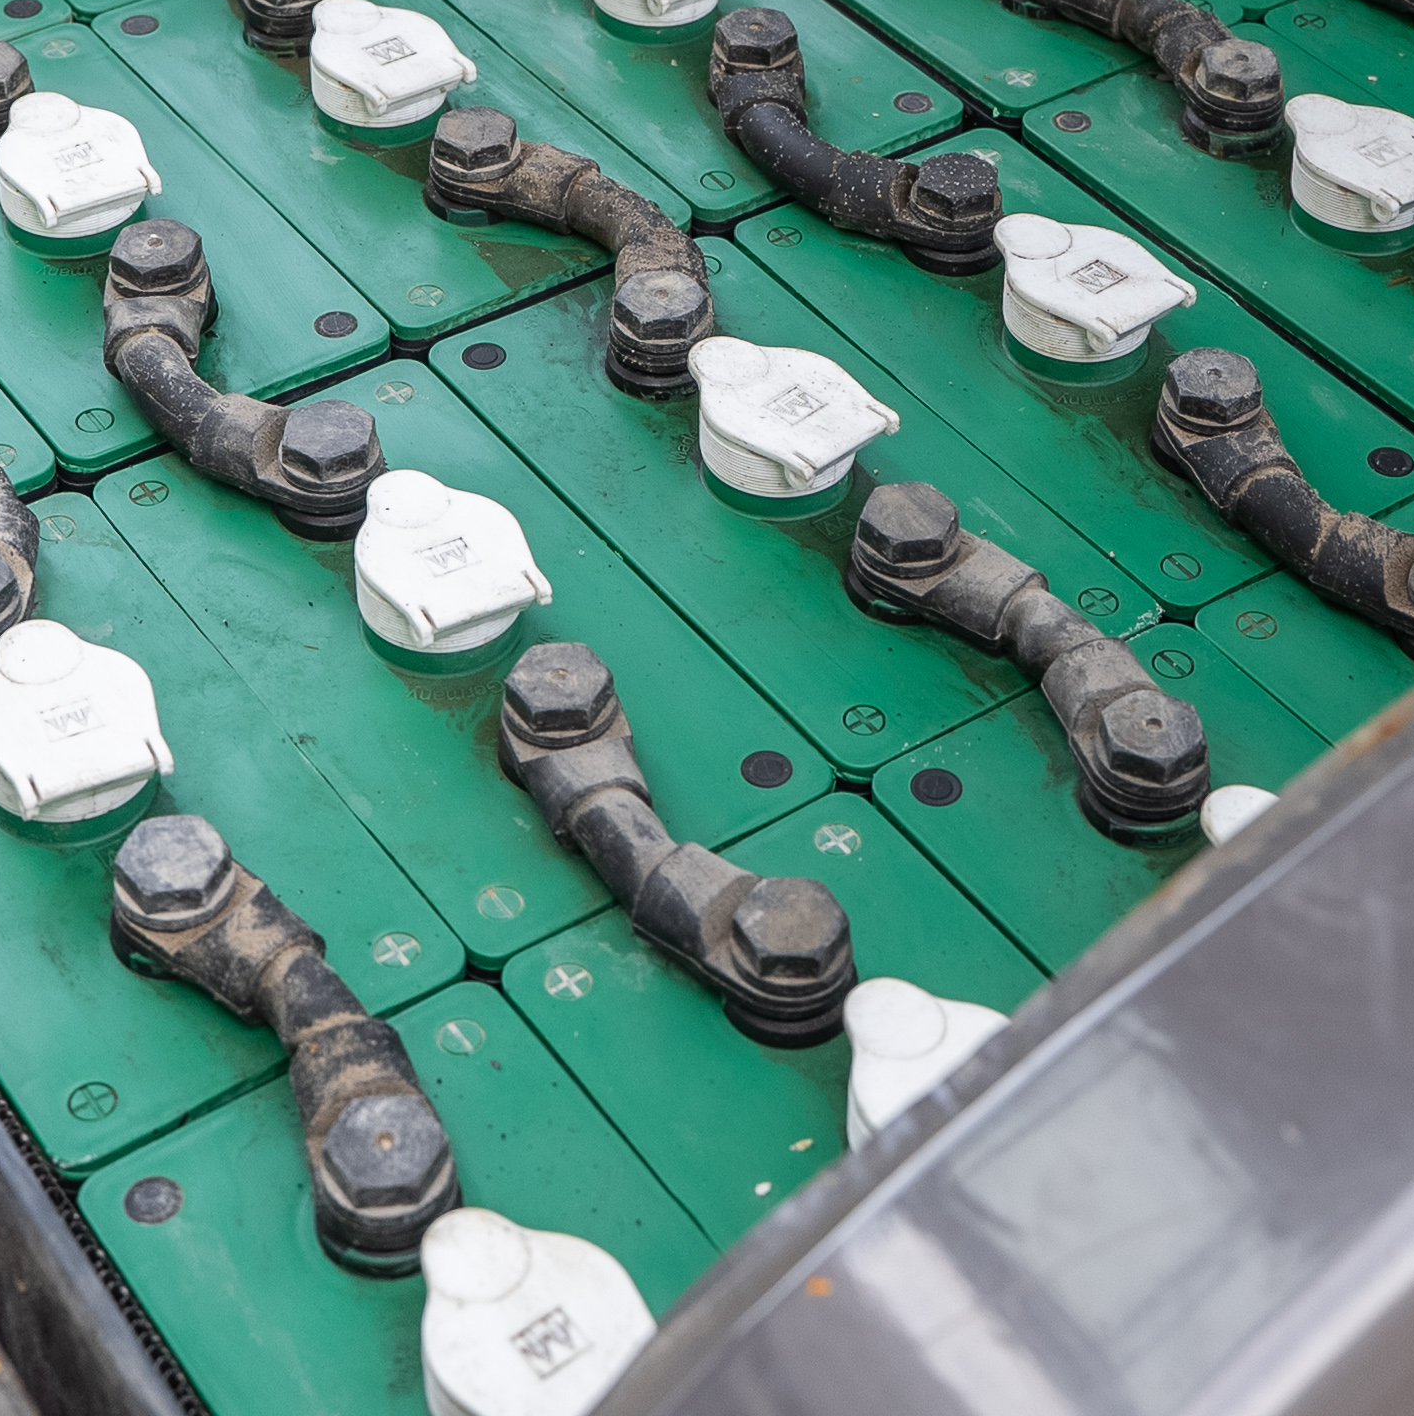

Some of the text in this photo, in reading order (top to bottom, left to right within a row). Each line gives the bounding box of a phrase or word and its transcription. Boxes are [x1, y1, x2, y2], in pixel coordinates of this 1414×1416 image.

[35, 264, 110, 279] ermany
[1086, 640, 1106, 655] 70
[404, 678, 506, 705] Germany
